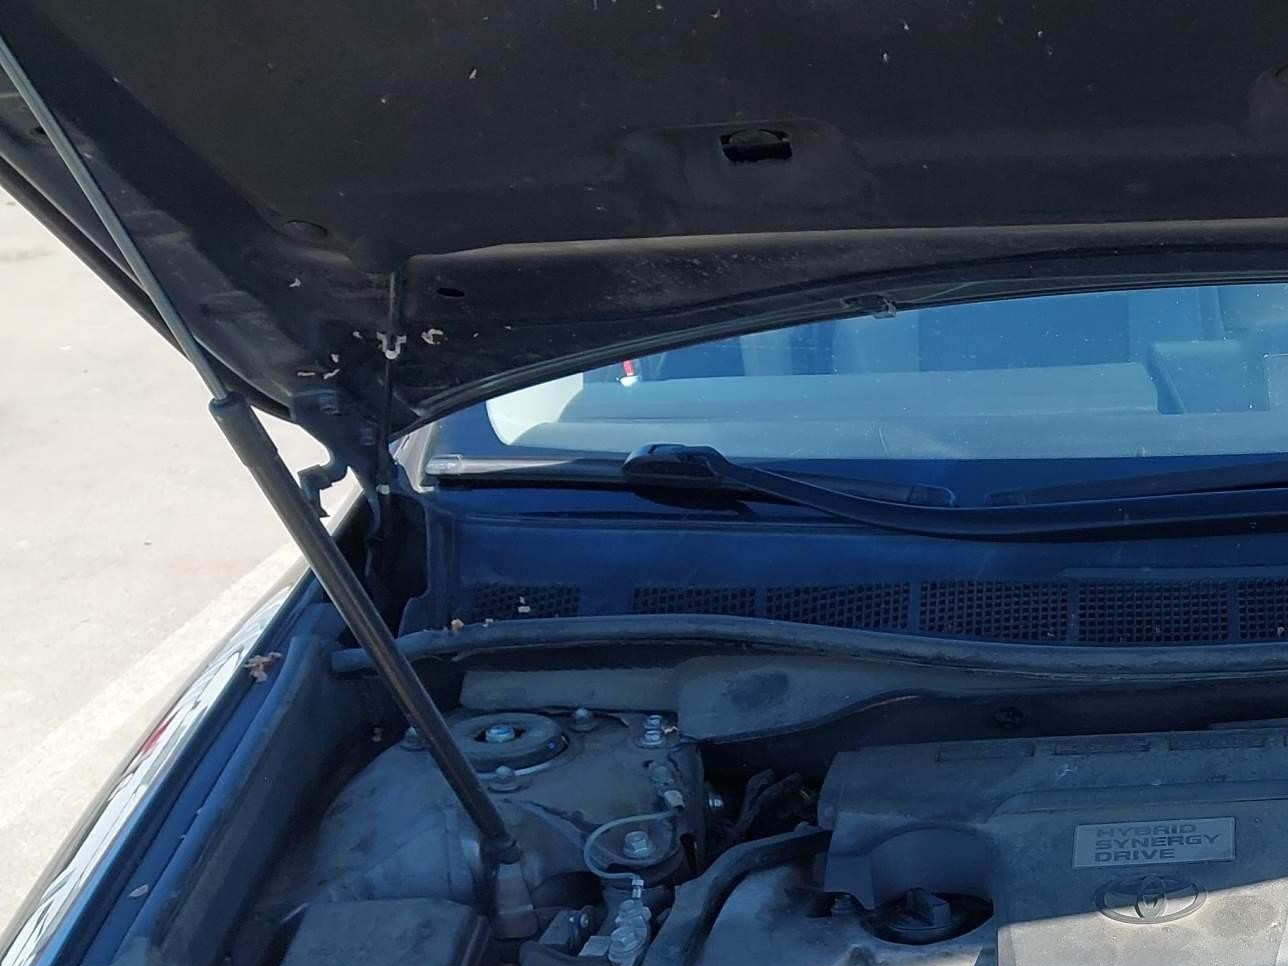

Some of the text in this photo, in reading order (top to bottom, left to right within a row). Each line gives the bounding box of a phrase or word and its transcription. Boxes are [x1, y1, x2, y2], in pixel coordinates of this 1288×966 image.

[1096, 823, 1197, 838] HYBRID
[1095, 833, 1220, 850] SYNERGY
[1094, 848, 1176, 863] DRIVE
